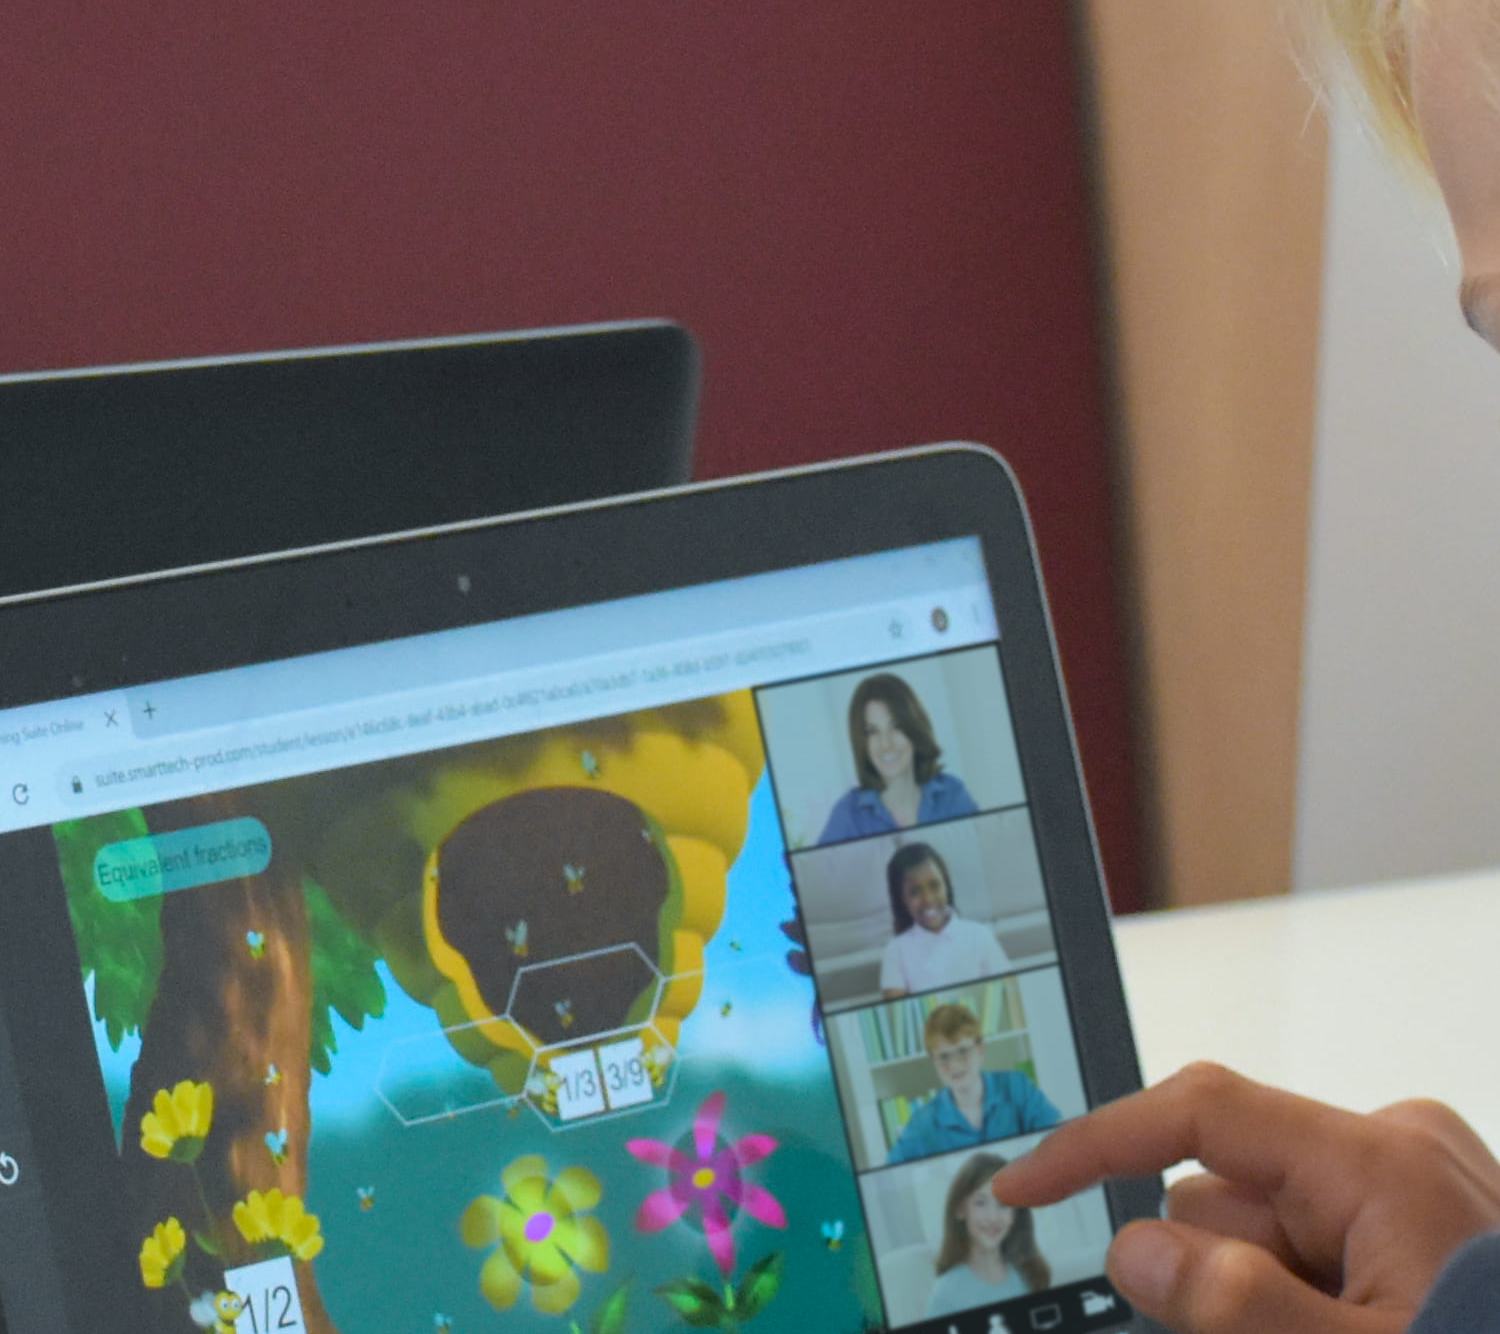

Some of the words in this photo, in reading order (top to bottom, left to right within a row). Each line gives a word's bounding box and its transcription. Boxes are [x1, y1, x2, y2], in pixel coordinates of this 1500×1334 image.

[98, 850, 190, 888] Equivalent
[193, 836, 267, 865] fractions
[560, 1067, 597, 1102] 1/3
[608, 1057, 645, 1091] 3/9
